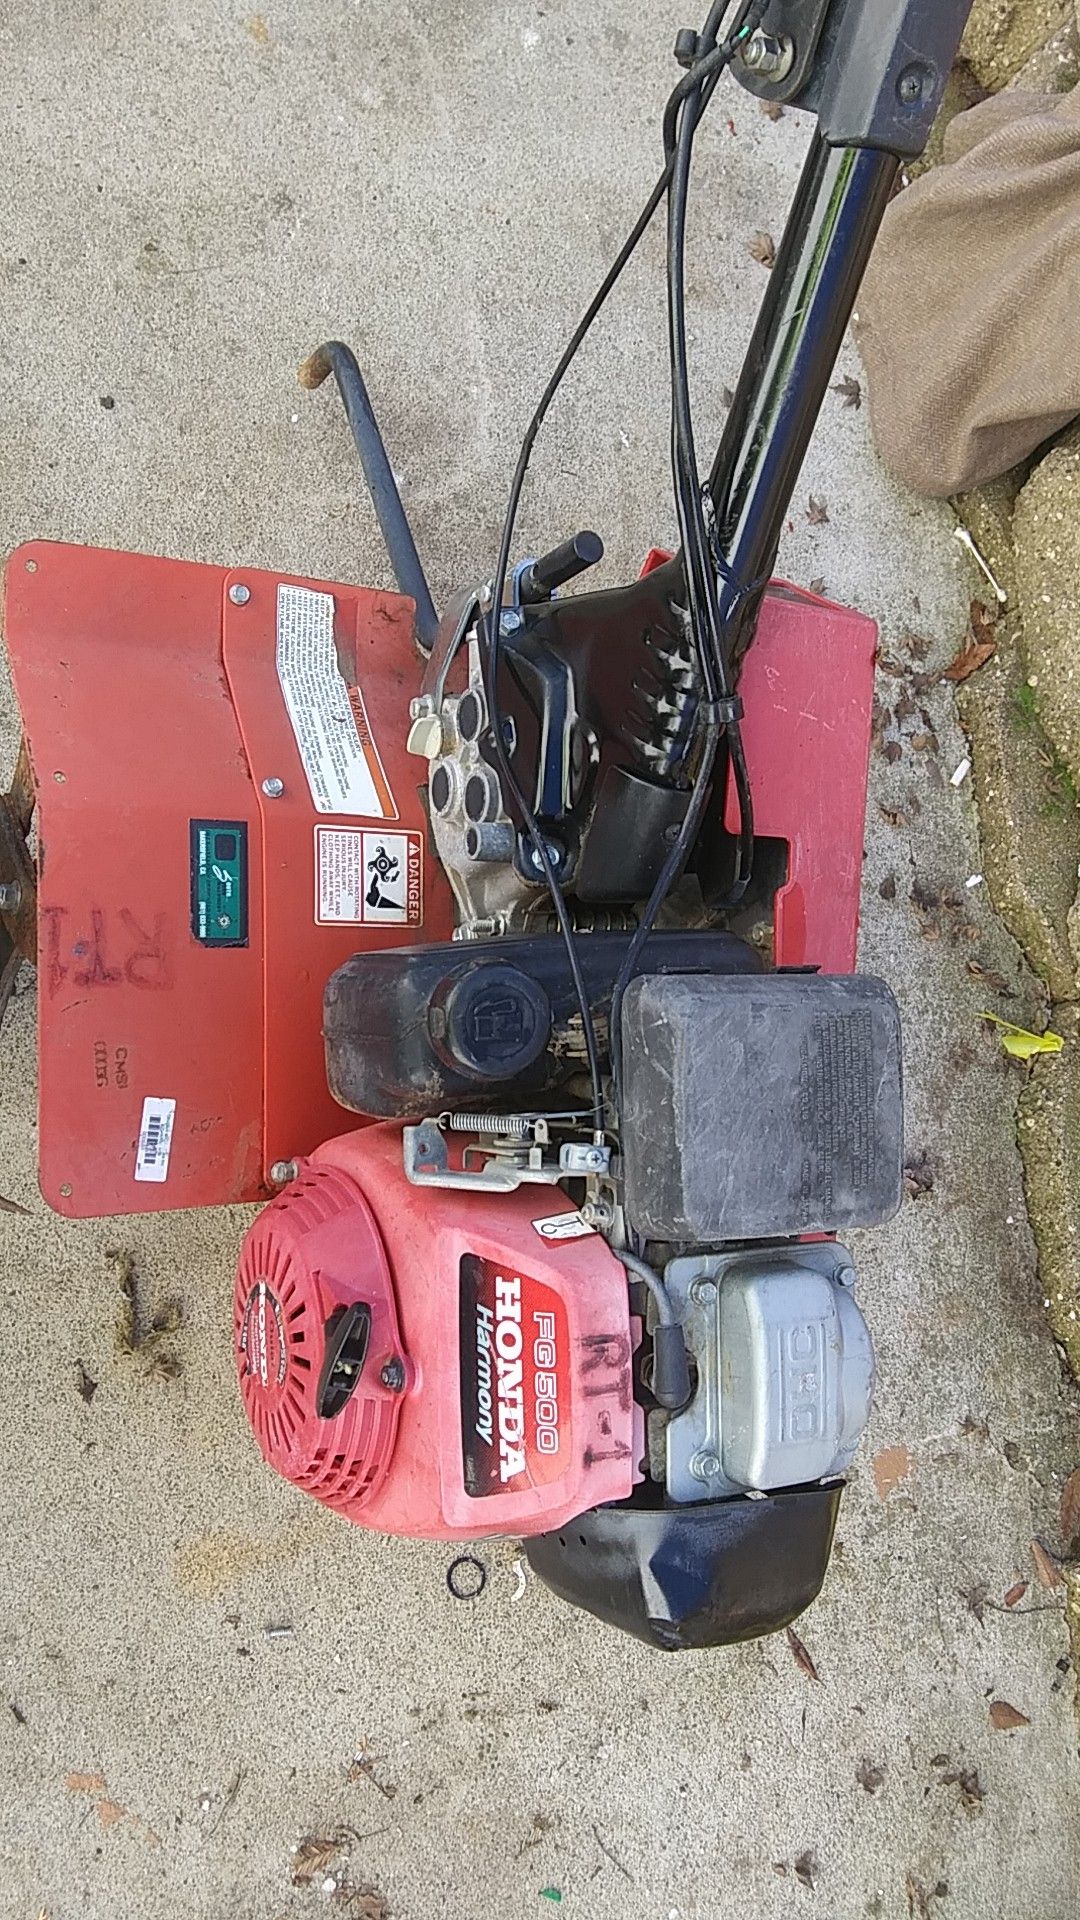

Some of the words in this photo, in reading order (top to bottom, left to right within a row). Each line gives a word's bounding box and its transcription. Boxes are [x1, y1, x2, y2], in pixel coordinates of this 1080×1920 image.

[307, 686, 315, 708] MACHINE
[325, 664, 334, 692] FUNCTIONS
[334, 682, 344, 709] CAREFULLY
[294, 680, 304, 707] REVERSING
[303, 717, 312, 738] PULLING
[312, 750, 322, 772] MACHINE
[320, 774, 330, 798] TOWARDS
[296, 710, 304, 723] STOP
[305, 746, 313, 761] AVOID
[307, 710, 316, 728] ENGINE
[314, 736, 323, 759] RUNNING
[309, 674, 319, 699] MANUALLY
[331, 758, 340, 777] MAKING
[316, 680, 328, 716] UNINSTRUCTED
[326, 718, 334, 736] ADULTS
[340, 768, 351, 790] MACHINE
[339, 683, 347, 702] AVOID
[346, 703, 355, 729] SERIOUS
[352, 731, 361, 752] INJURY
[350, 695, 370, 746] WARNING
[338, 745, 349, 768] WORKING
[409, 859, 419, 919] DANGER
[474, 1303, 494, 1446] Harmony
[495, 1276, 526, 1483] HONDA
